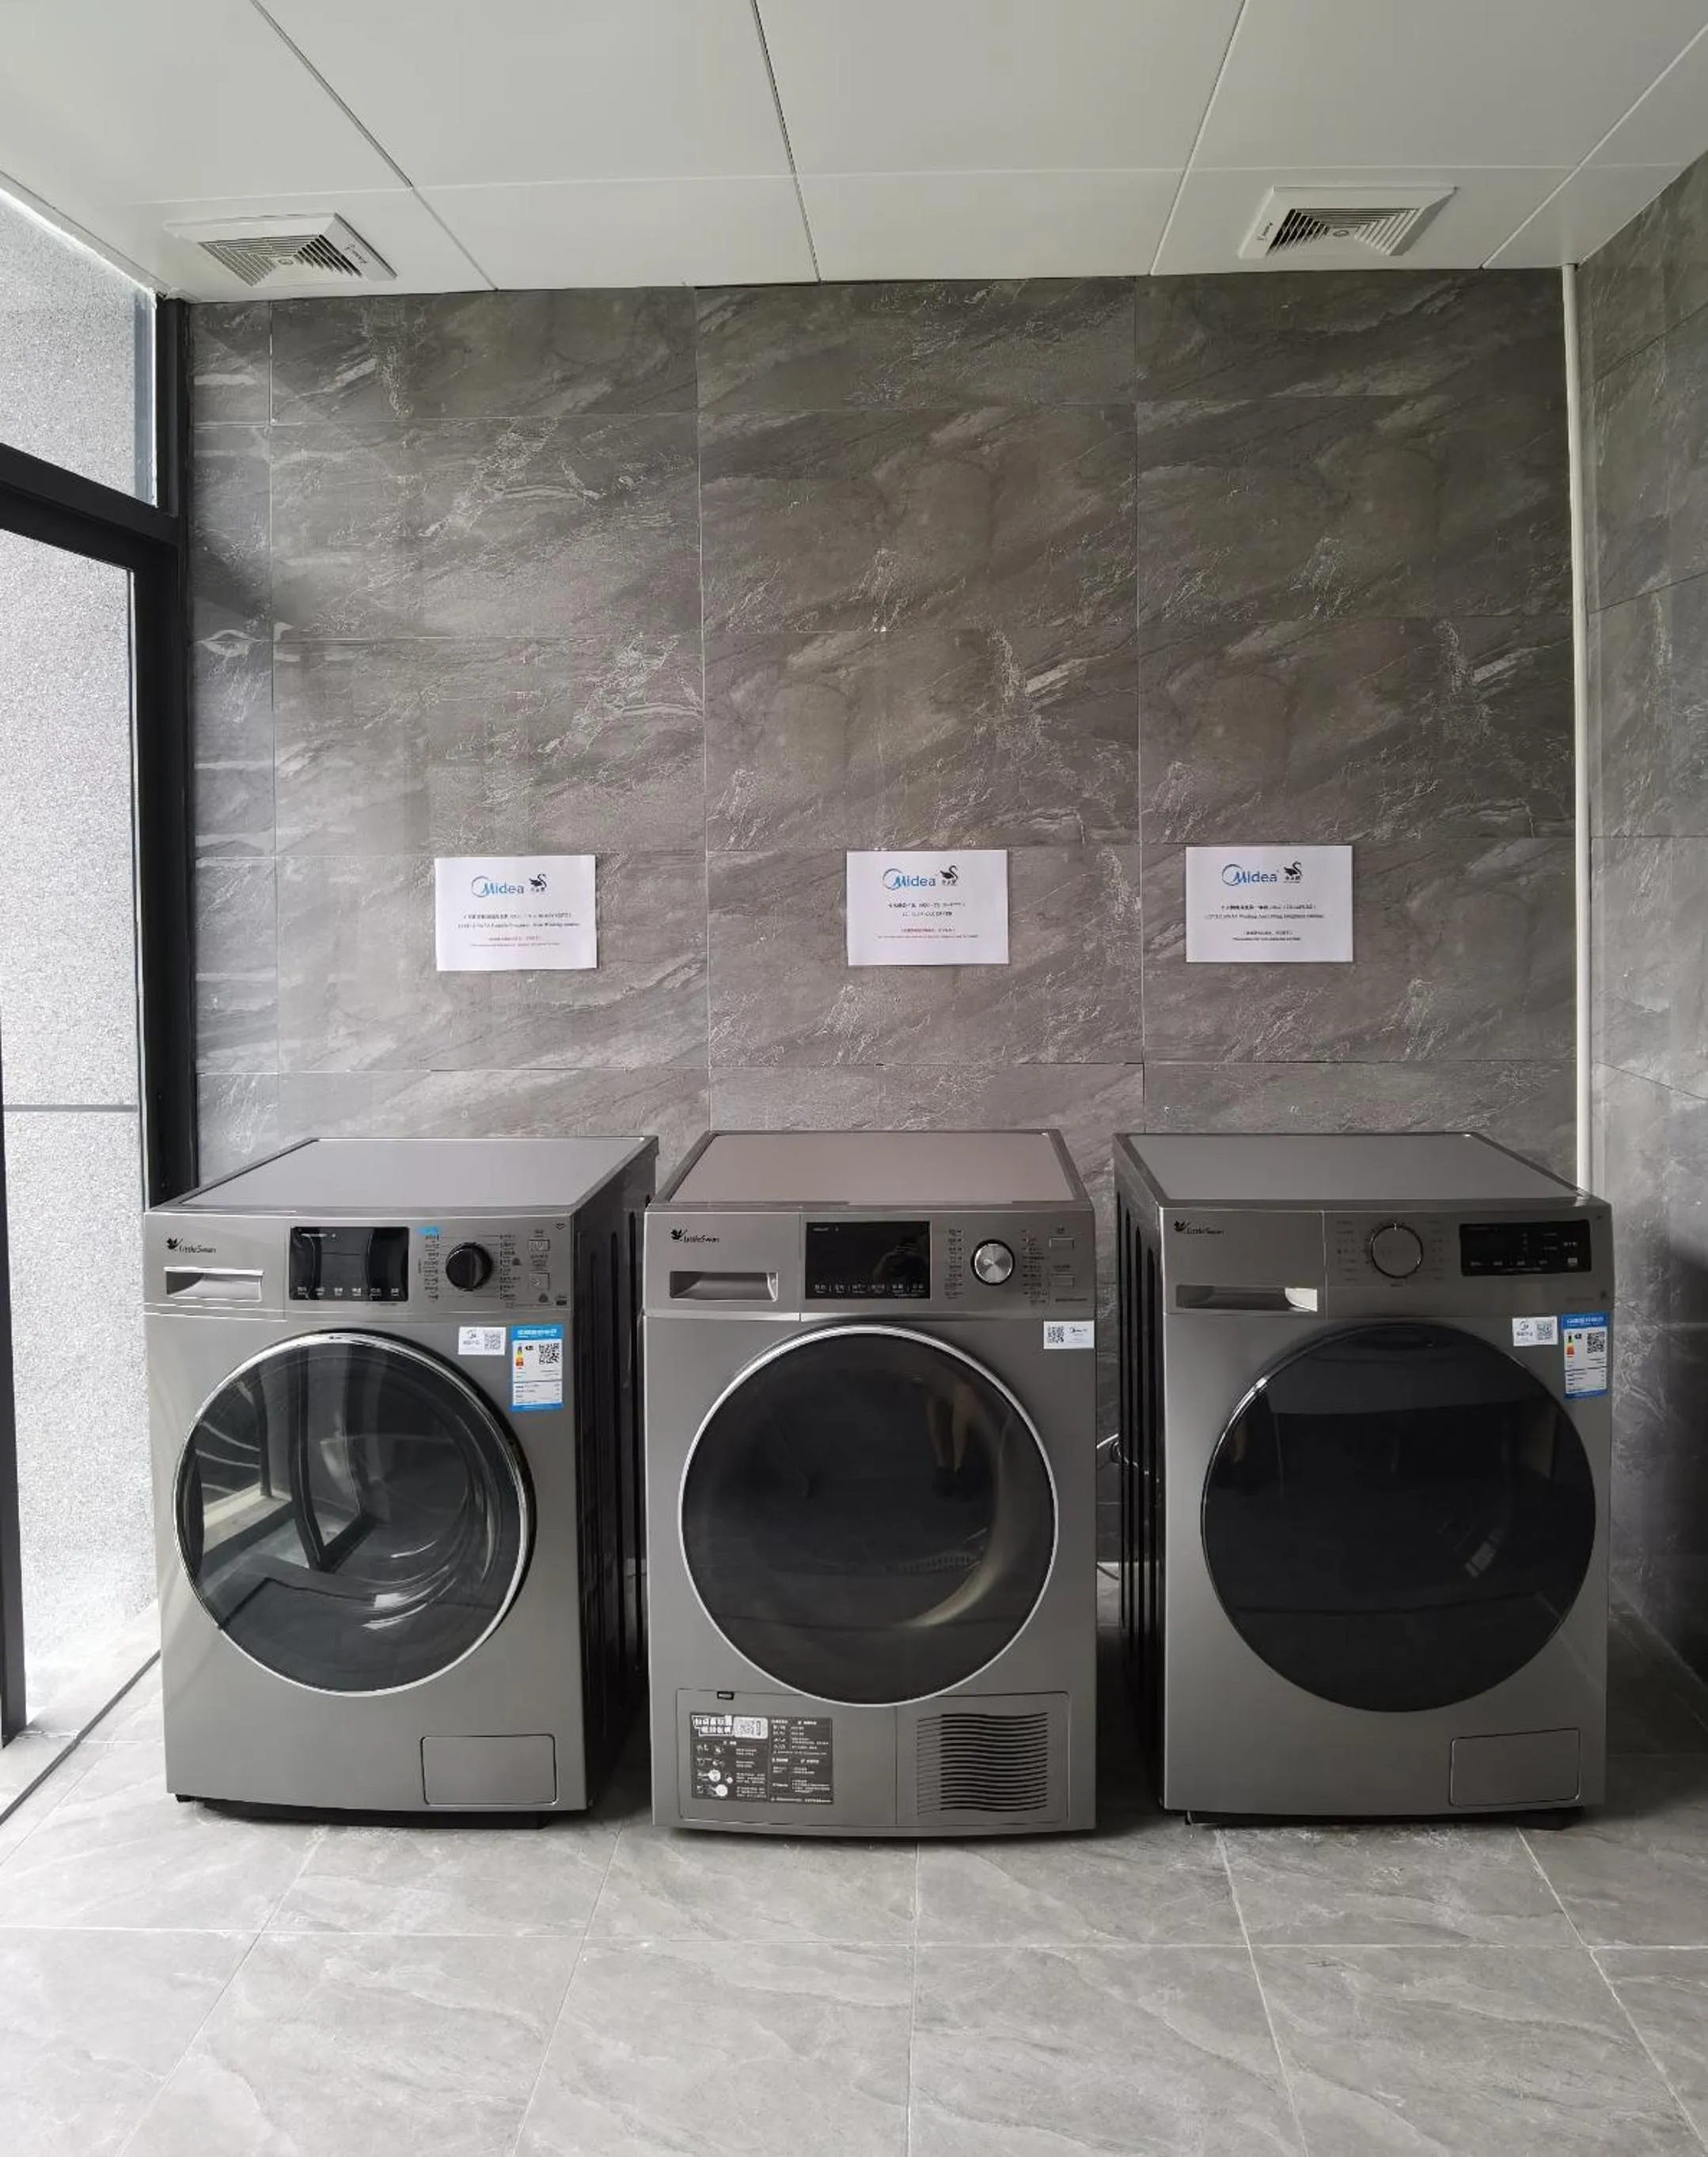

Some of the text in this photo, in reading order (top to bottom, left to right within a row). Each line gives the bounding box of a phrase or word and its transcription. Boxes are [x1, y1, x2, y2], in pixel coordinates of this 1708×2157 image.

[883, 872, 936, 889] Midea
[1222, 867, 1277, 884] Midea
[473, 879, 525, 896] Midea
